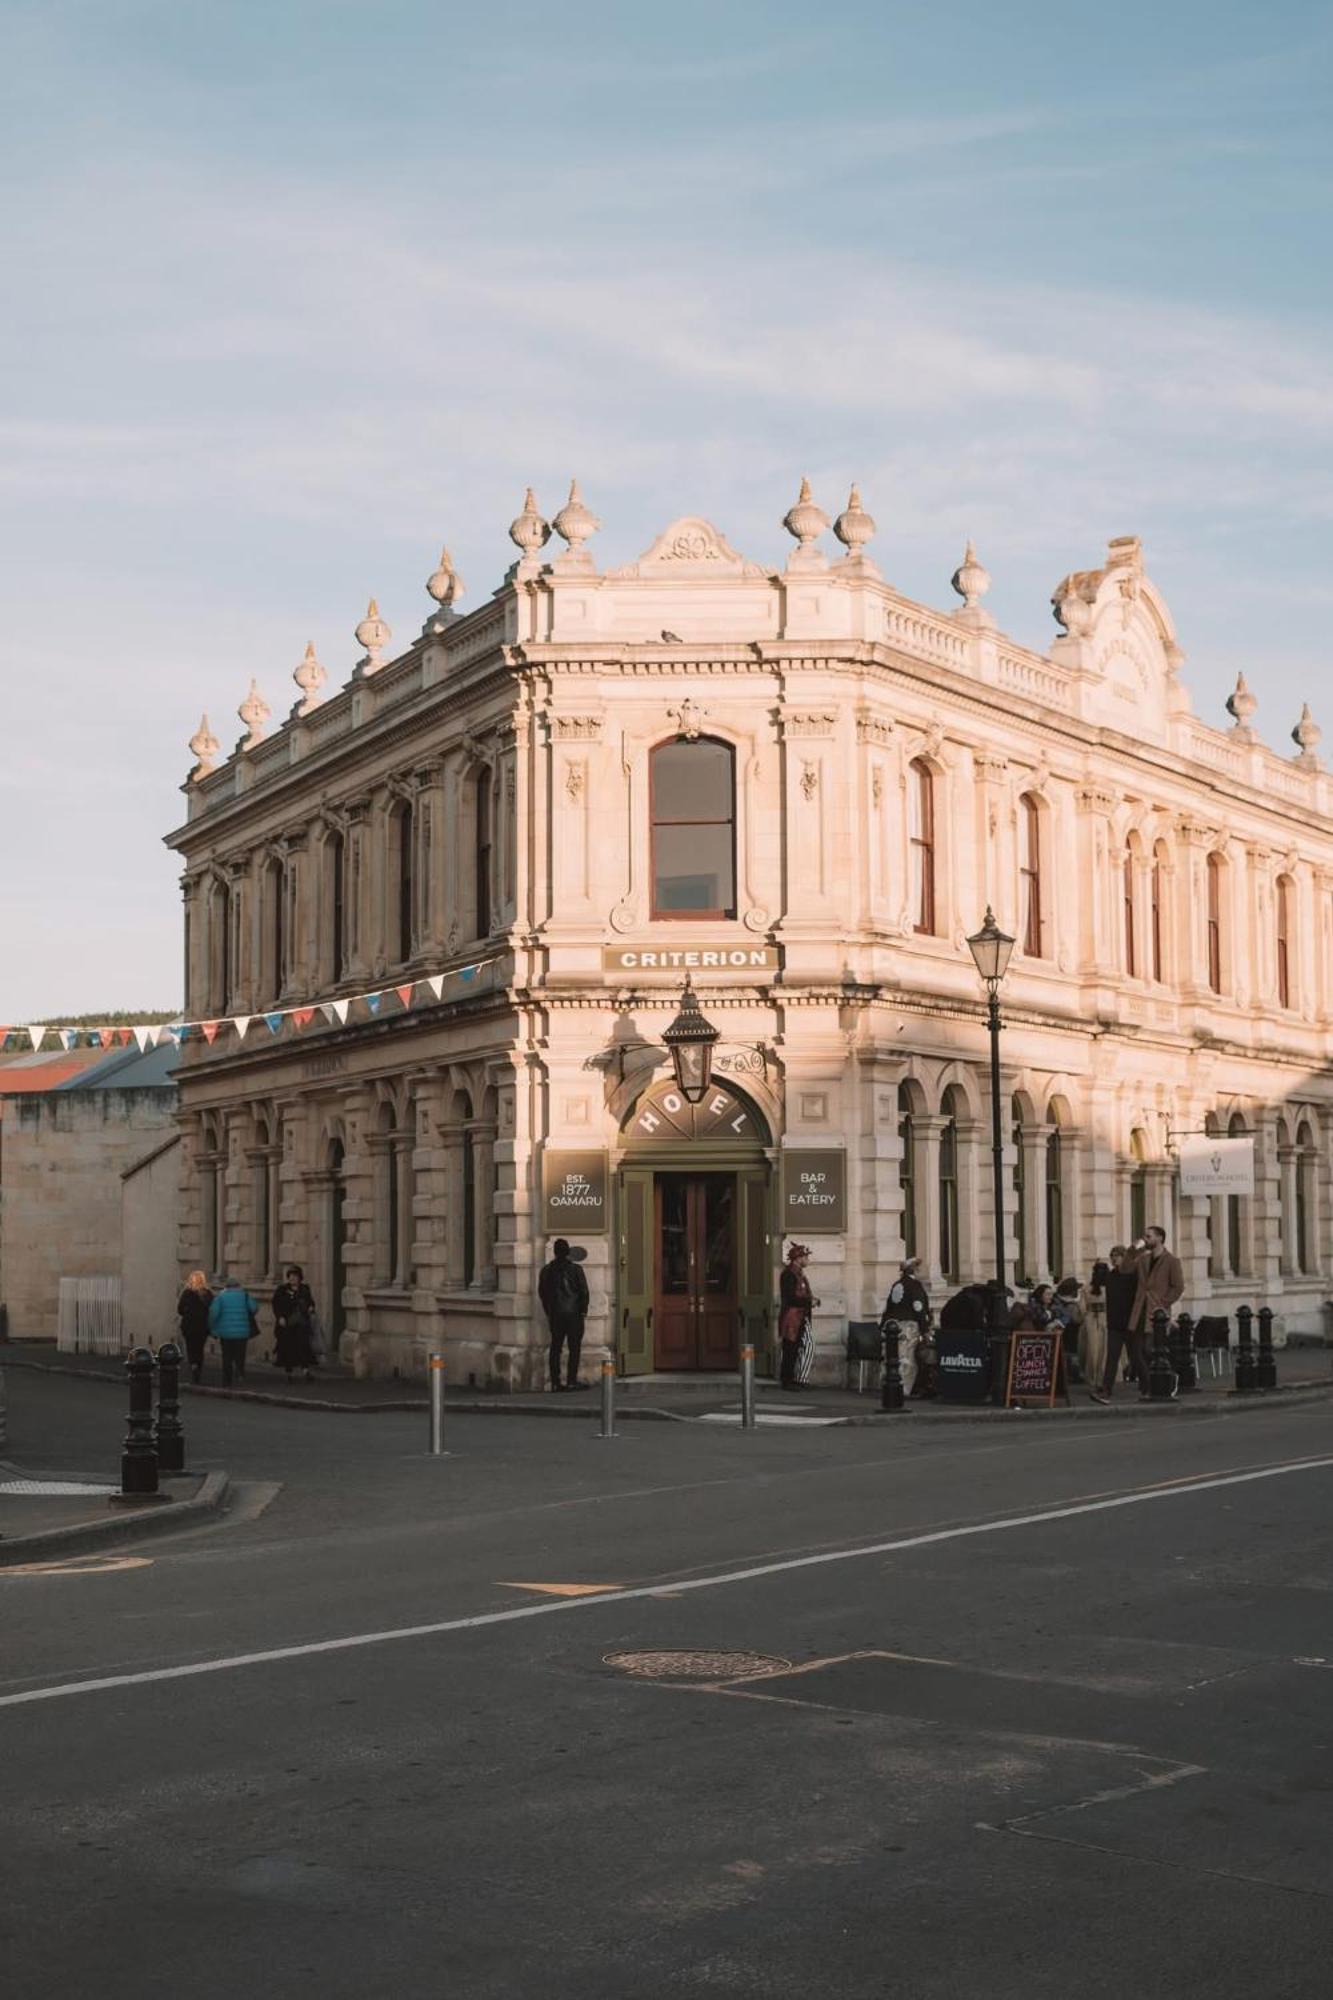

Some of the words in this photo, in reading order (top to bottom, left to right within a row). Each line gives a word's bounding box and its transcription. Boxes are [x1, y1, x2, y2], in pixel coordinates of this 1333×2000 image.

[620, 951, 767, 967] CRITERION
[638, 1093, 747, 1133] HOEL
[800, 1173, 826, 1183] BAR
[561, 1184, 590, 1195] 1877
[809, 1183, 817, 1193] &
[550, 1196, 602, 1206] OAMARU
[789, 1194, 836, 1205] EATERY
[1016, 1344, 1050, 1360] OPEN
[940, 1354, 982, 1367] LAVAZZA
